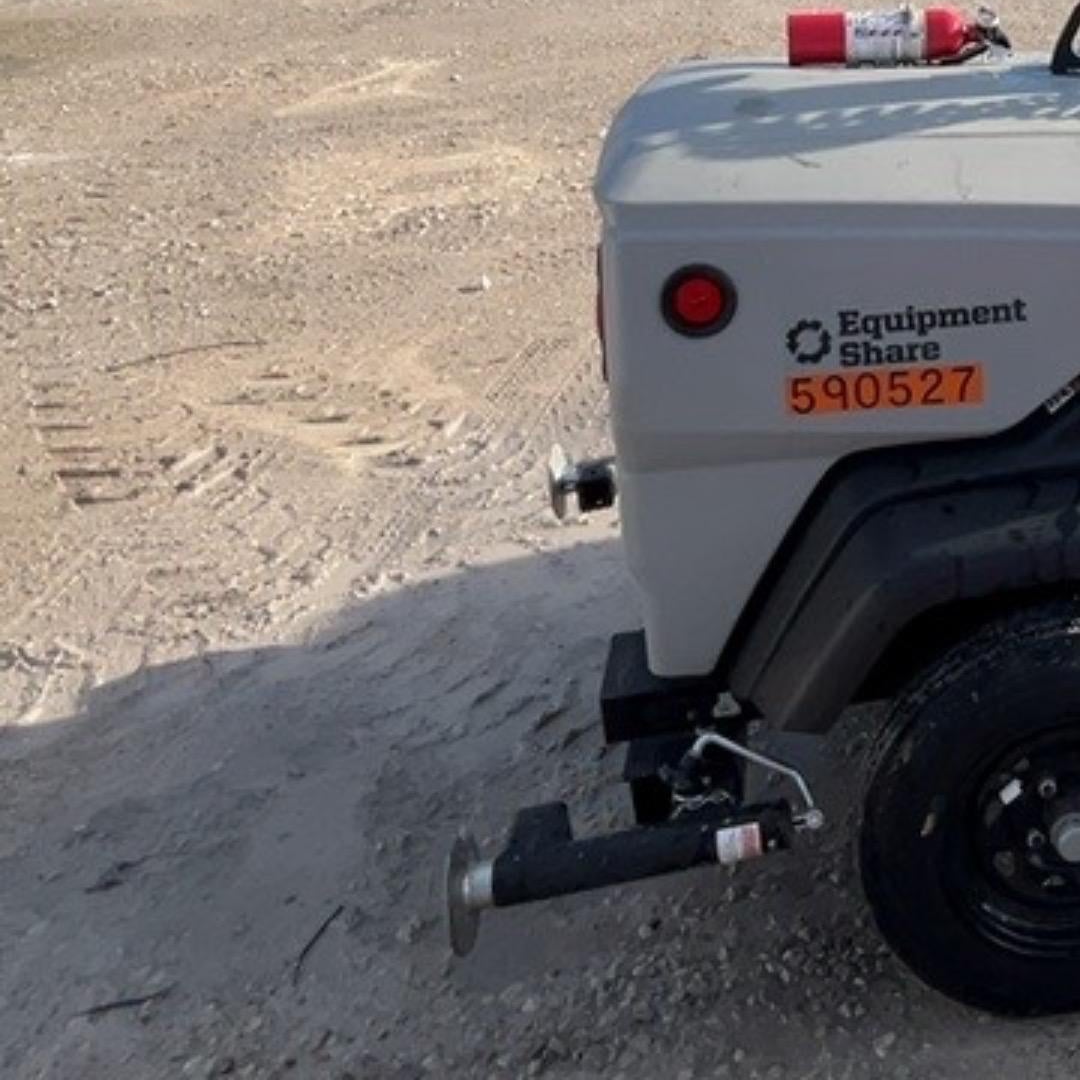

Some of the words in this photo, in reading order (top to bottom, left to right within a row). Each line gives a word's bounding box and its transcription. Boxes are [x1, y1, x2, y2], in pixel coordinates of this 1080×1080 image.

[837, 299, 1027, 339] Equipment
[839, 340, 941, 366] Share
[790, 366, 977, 414] 590527
